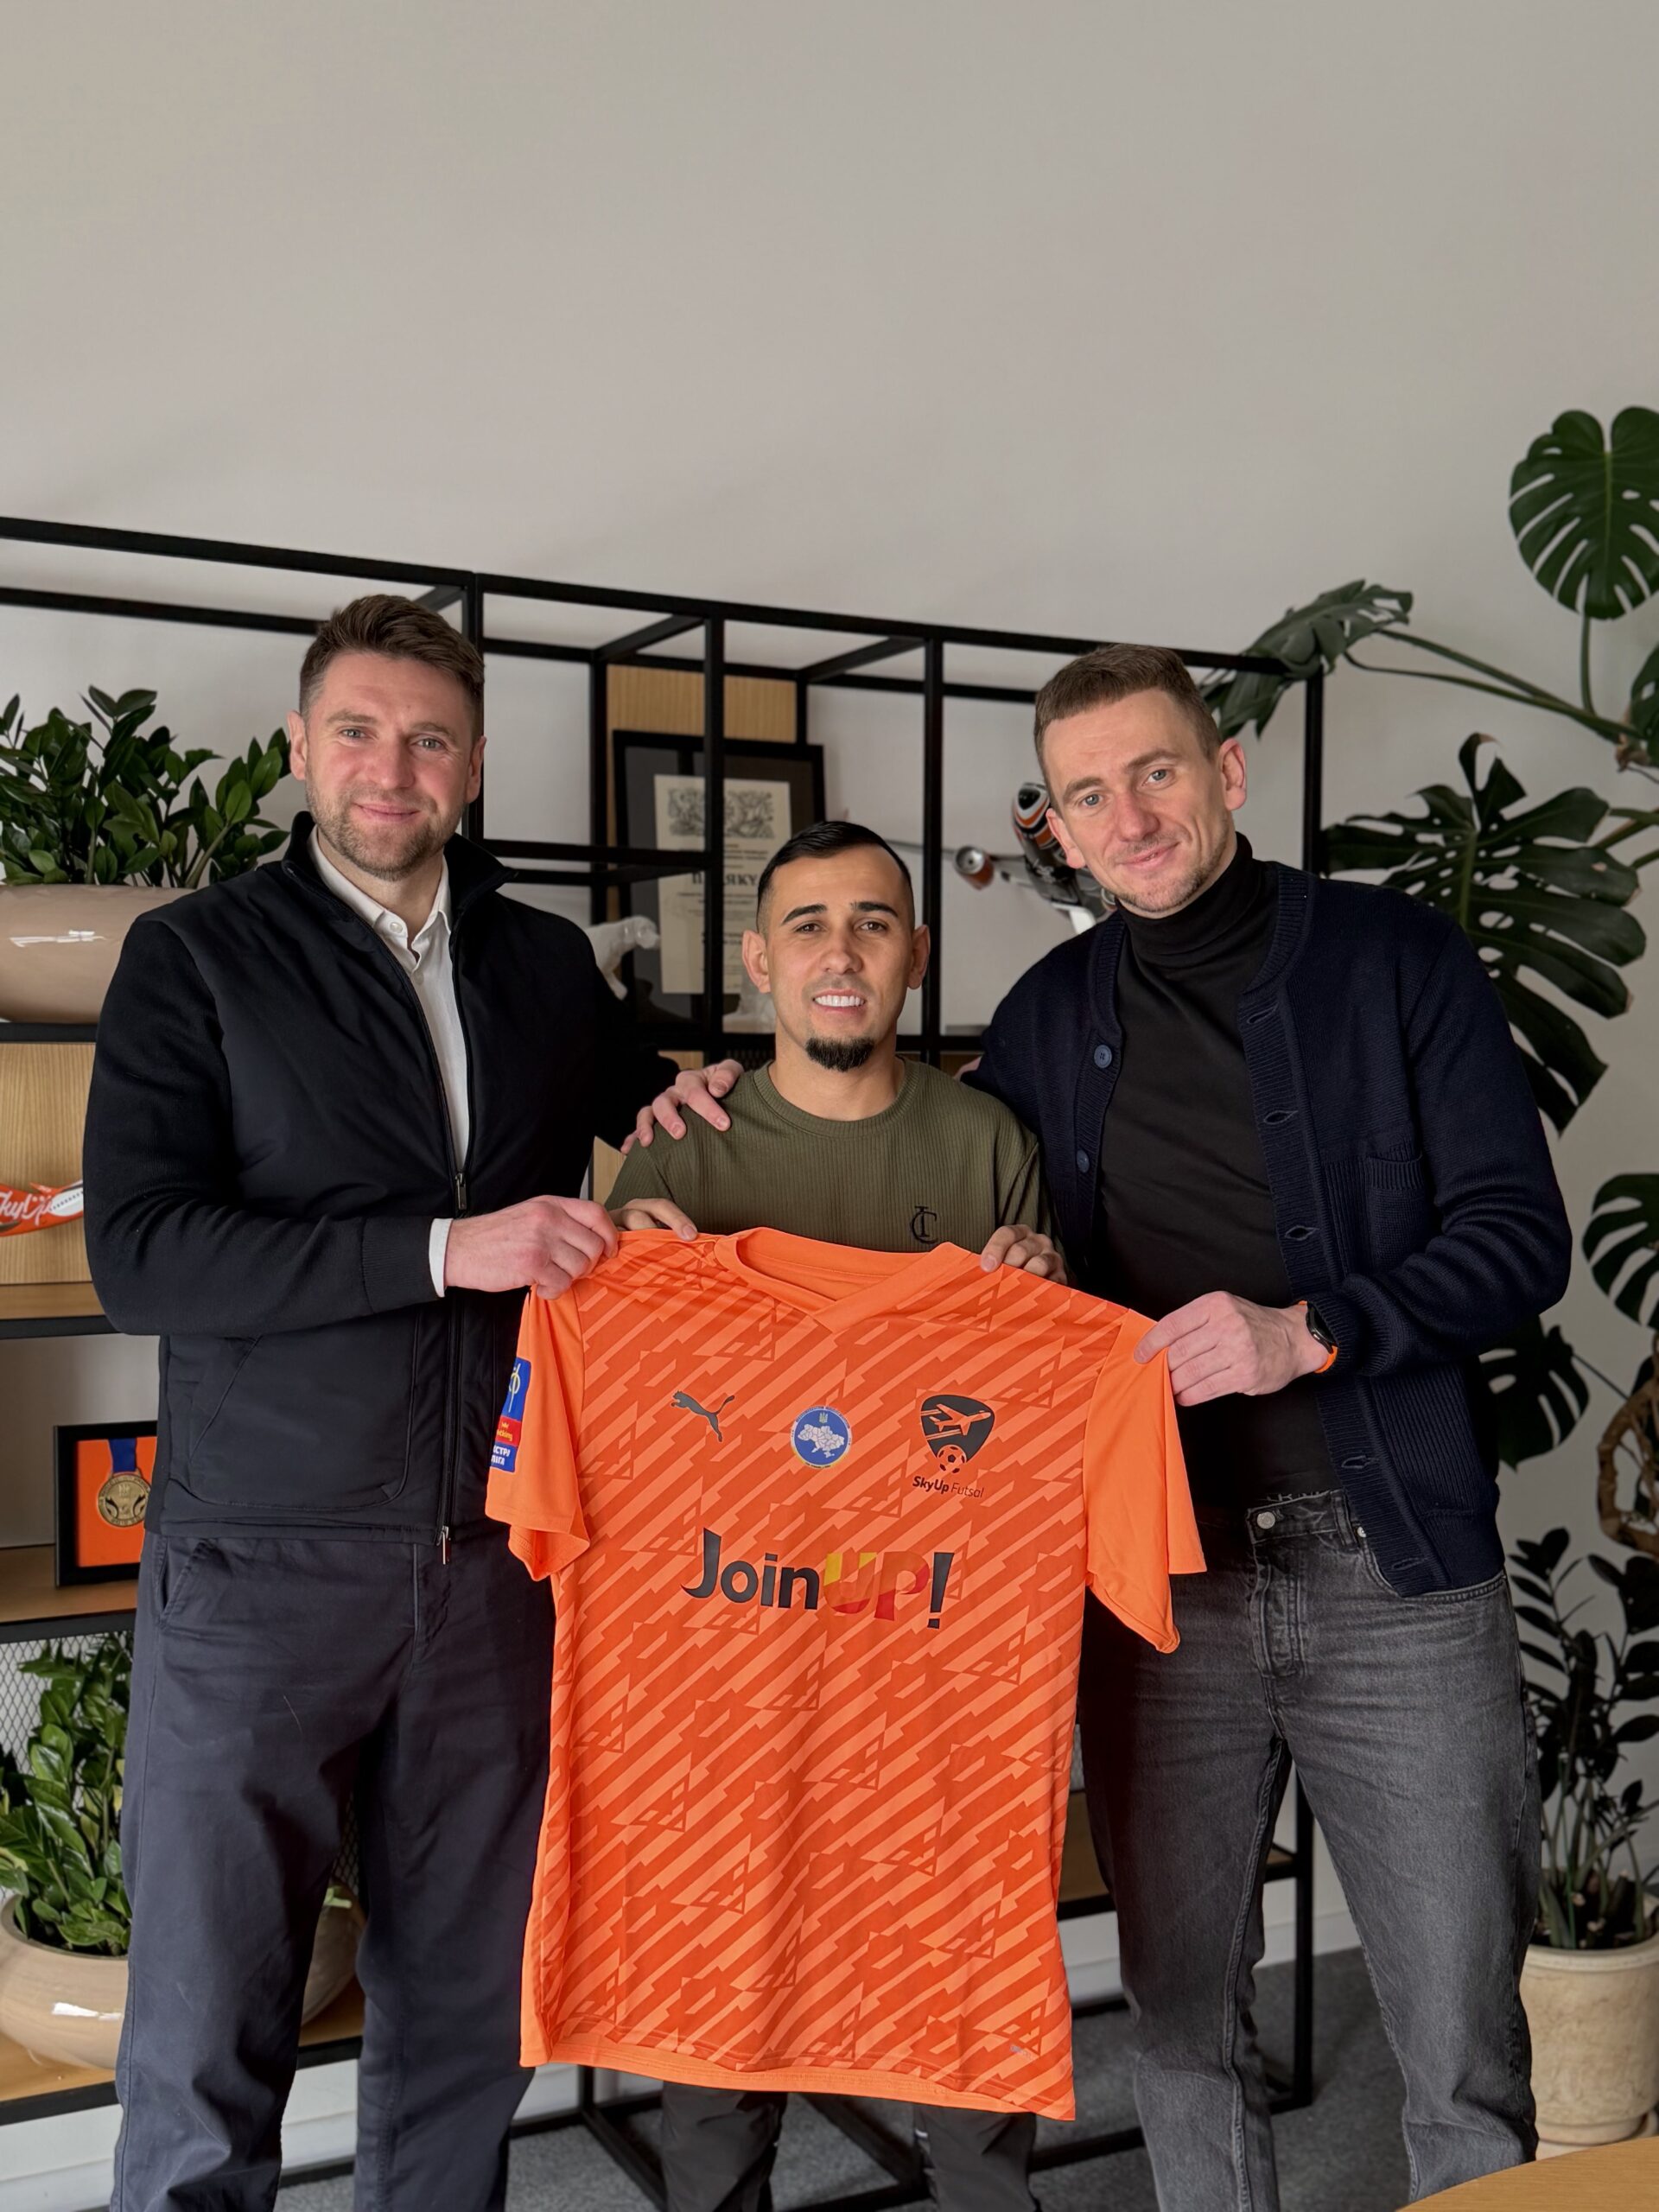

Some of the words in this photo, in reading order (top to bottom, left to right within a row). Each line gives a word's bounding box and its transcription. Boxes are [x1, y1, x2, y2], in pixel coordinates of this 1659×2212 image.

[691, 872, 758, 887] ПЯКУ
[912, 1476, 949, 1495] SkyUp
[951, 1483, 984, 1498] Futsal
